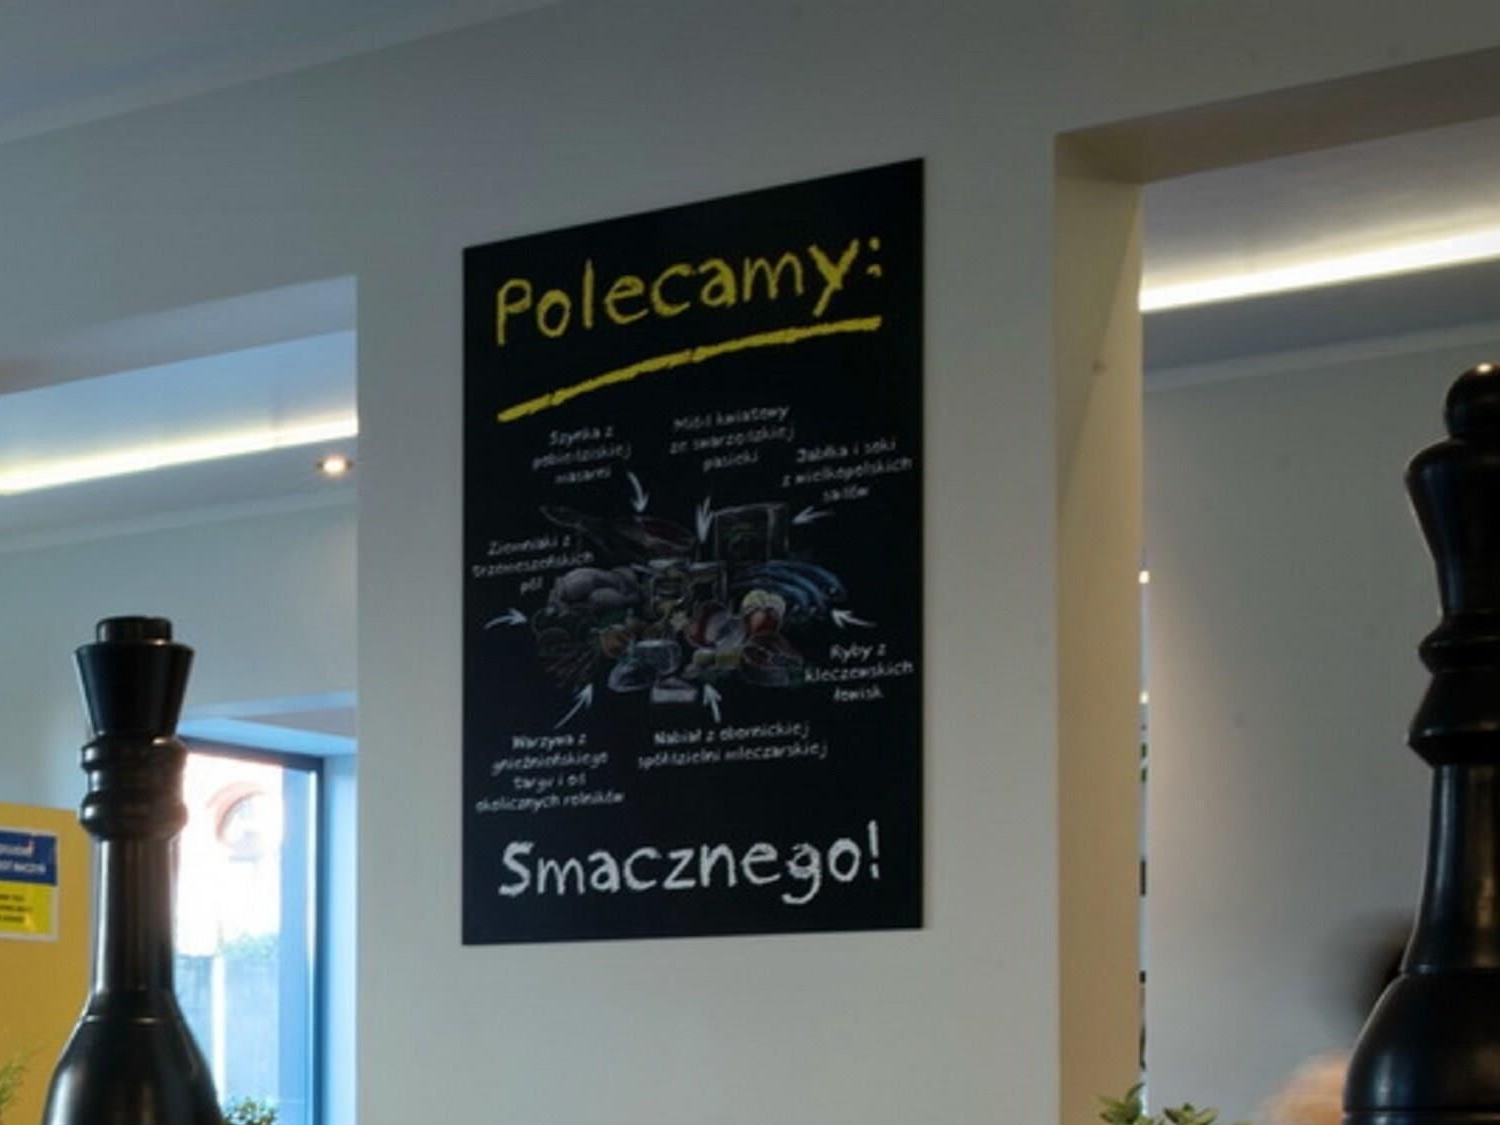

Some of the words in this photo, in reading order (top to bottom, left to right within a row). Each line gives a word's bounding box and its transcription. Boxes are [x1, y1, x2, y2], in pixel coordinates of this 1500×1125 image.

[495, 236, 883, 346] Polecamy:
[829, 642, 874, 663] Ryby
[724, 740, 829, 761] mleczarskiej
[475, 793, 560, 814] okolicznych
[498, 819, 881, 906] Smacznego!
